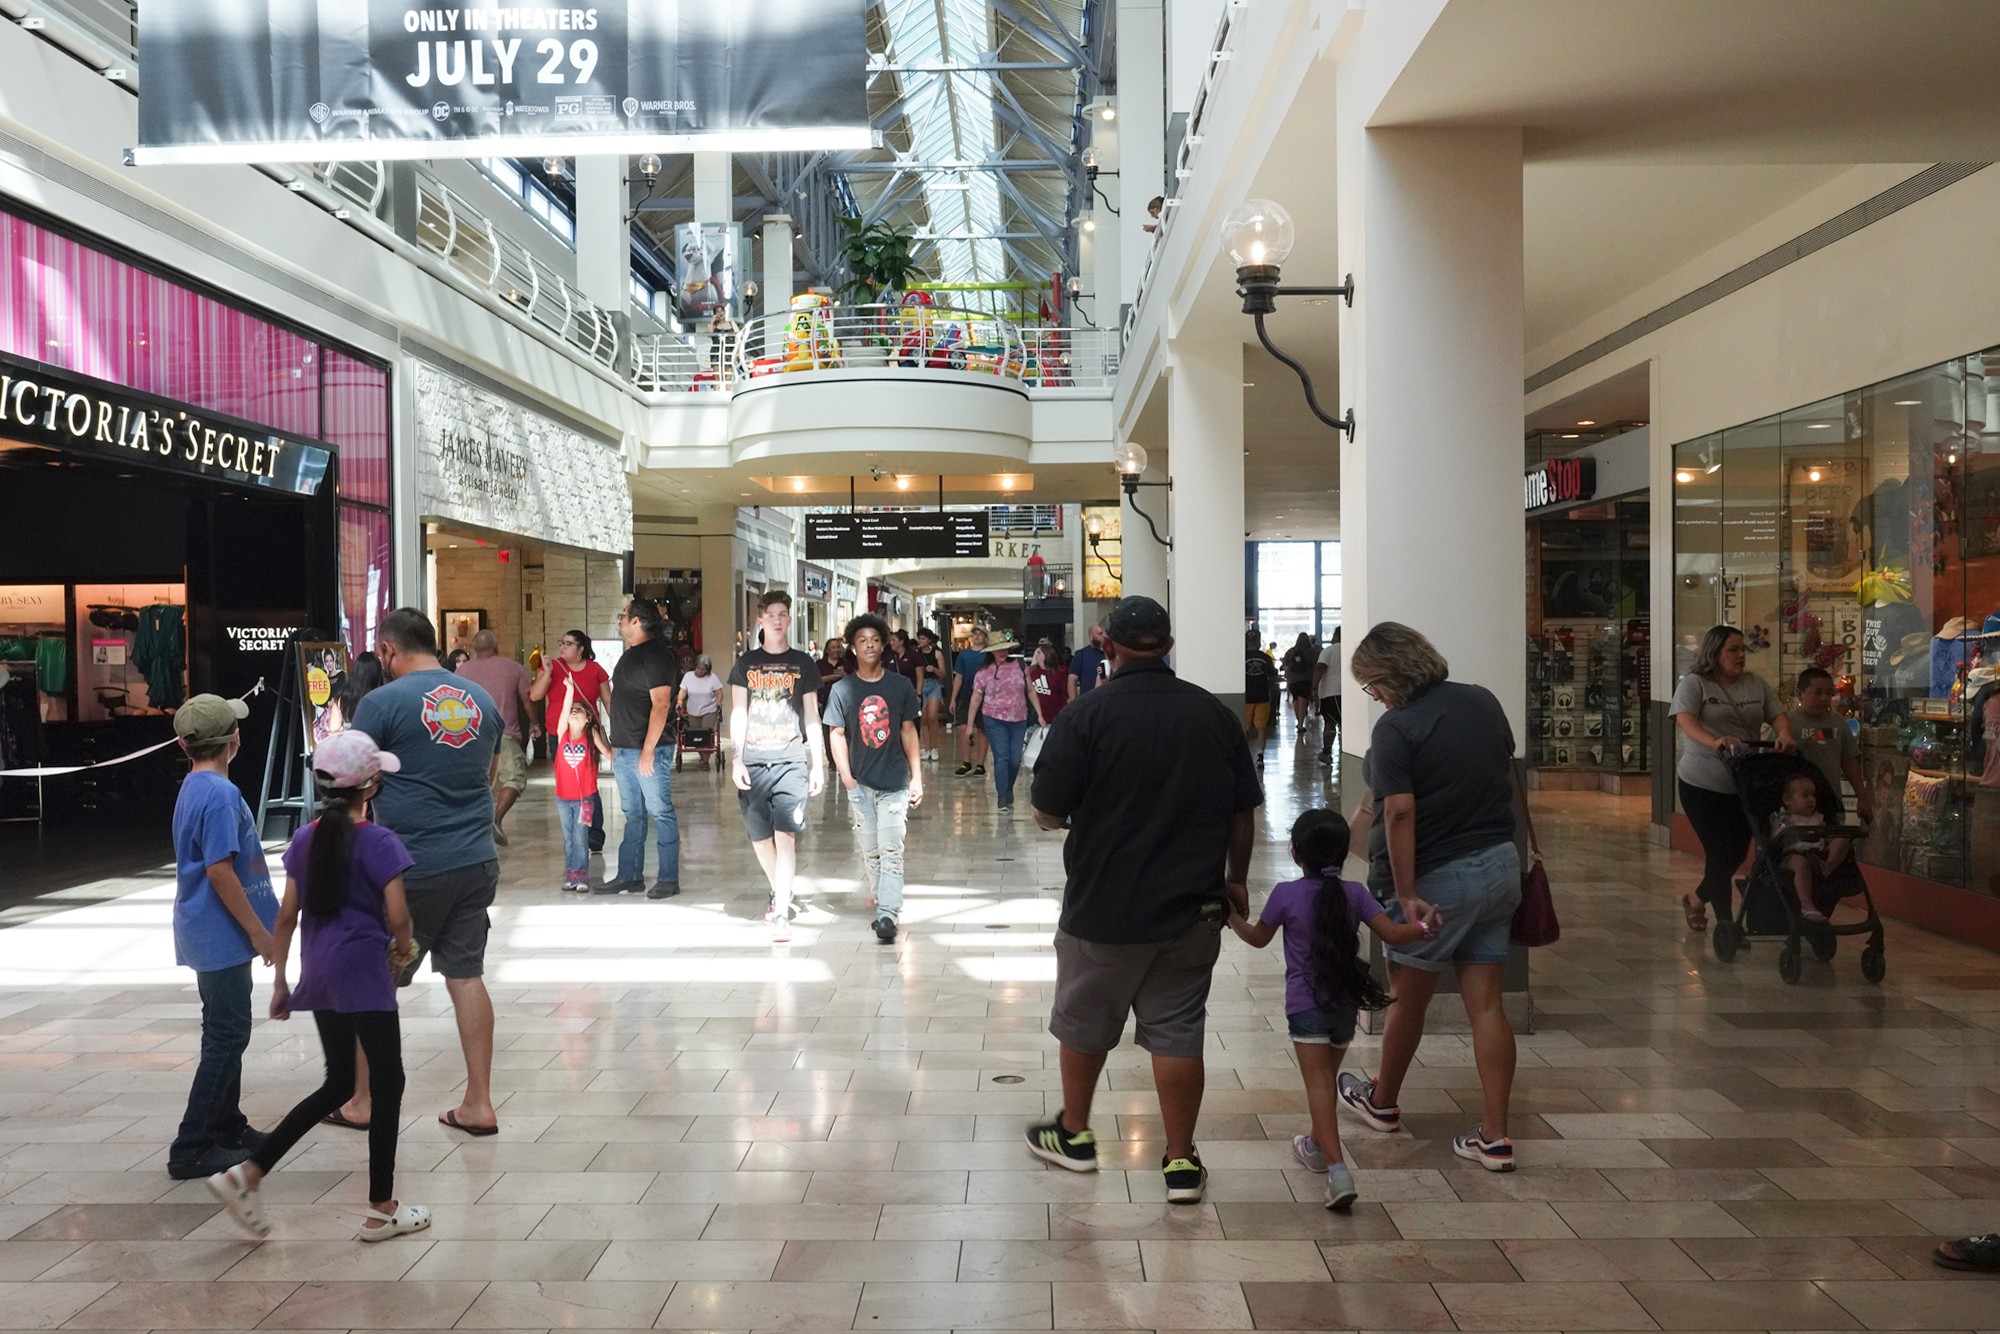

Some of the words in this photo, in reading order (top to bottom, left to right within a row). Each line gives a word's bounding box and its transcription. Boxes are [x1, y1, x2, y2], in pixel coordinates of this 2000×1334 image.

[404, 9, 459, 32] ONLY
[464, 8, 488, 31] IN
[494, 7, 598, 30] THEATERS
[405, 38, 522, 88] JULY
[536, 38, 599, 84] 29
[433, 104, 449, 119] DC
[514, 105, 549, 113] WATERTOWER
[557, 103, 580, 115] PG
[641, 101, 673, 111] WARNER
[674, 101, 696, 111] BROS.
[332, 109, 362, 117] WARNER
[363, 107, 403, 116] ANIMATION
[404, 108, 429, 116] GROUP
[0, 376, 174, 456] ICTORIA'S
[440, 428, 482, 468] JAMES
[493, 447, 529, 480] AVERY
[458, 473, 489, 493] artisan
[994, 541, 1041, 559] RKET
[17, 596, 43, 605] SEXY
[1866, 620, 1882, 628] THIS
[1865, 628, 1880, 636] GUY
[239, 640, 285, 651] SECRET
[308, 681, 329, 690] FREE
